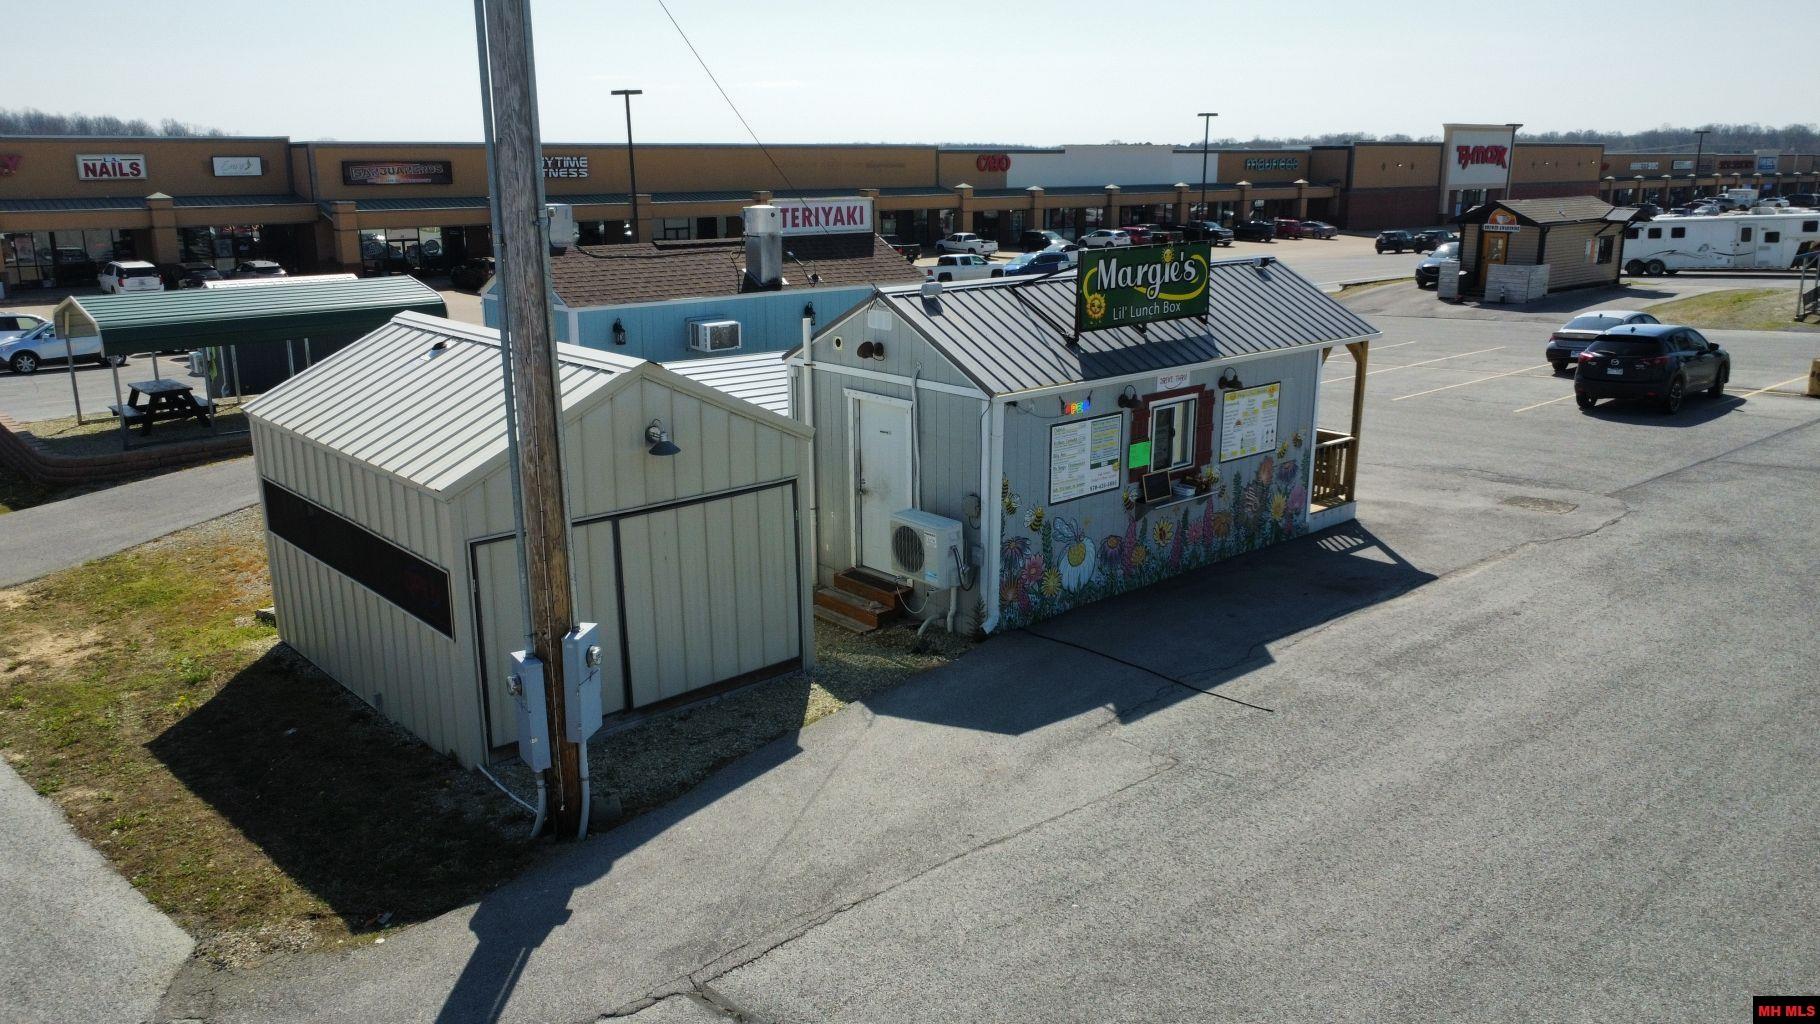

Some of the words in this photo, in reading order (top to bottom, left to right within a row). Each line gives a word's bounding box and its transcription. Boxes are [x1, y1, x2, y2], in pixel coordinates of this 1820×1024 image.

[83, 162, 141, 177] NAILS
[780, 205, 864, 229] TERIYAKI
[1097, 251, 1197, 300] Margie's
[1113, 306, 1127, 320] Lil'
[1130, 302, 1160, 318] Lunch
[1163, 301, 1181, 314] Box
[1064, 399, 1090, 415] OPEN
